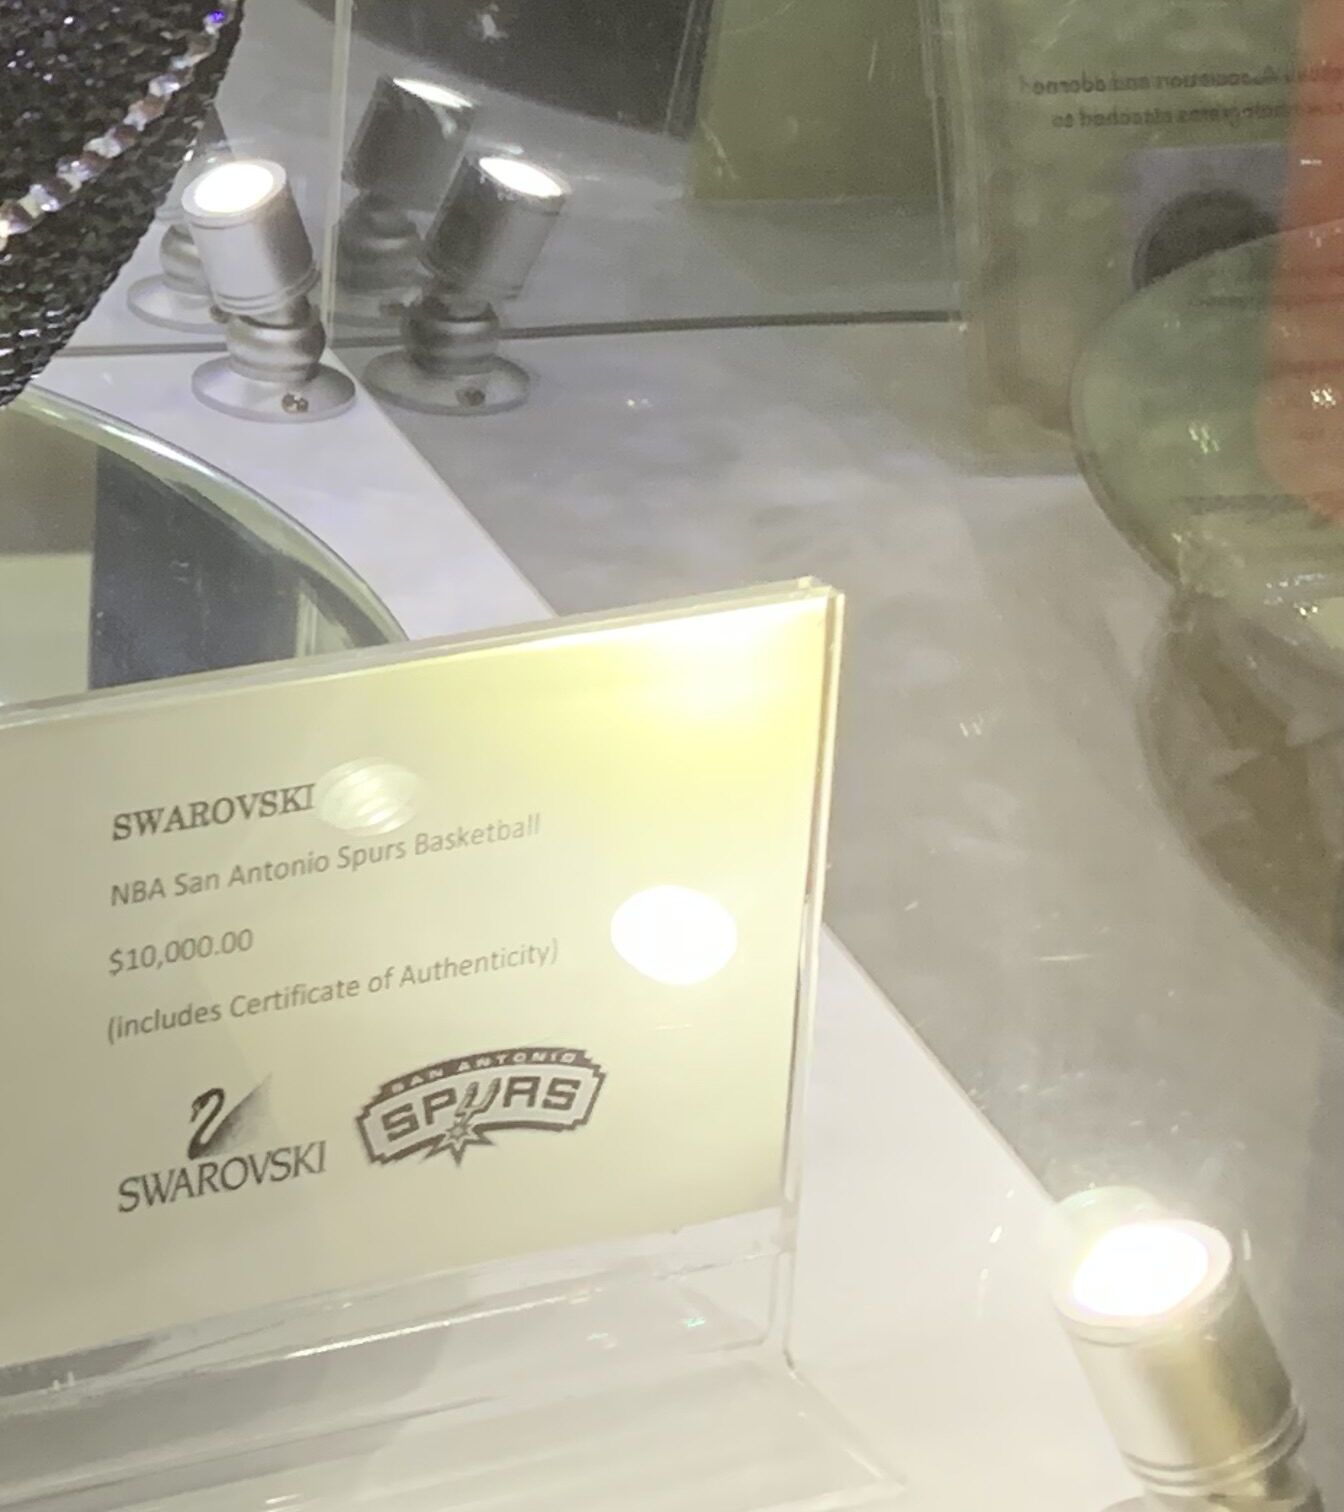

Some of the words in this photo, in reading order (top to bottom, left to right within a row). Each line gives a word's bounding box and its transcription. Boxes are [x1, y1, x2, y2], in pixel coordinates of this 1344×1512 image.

[111, 783, 316, 842] SWAROVSKI
[110, 877, 167, 907] NBA
[173, 871, 221, 898] San
[227, 850, 331, 888] Antonio
[336, 838, 407, 870] Spurs
[414, 812, 542, 856] Basketball
[108, 928, 254, 976] $10,000.00
[107, 999, 223, 1046] (includes
[229, 978, 361, 1019] Certificate
[367, 965, 396, 993] of
[398, 937, 560, 988] Authenticity)
[391, 1068, 443, 1094] SAN
[457, 1052, 577, 1075] ANTONIO
[117, 1140, 328, 1213] SWAROVSKI
